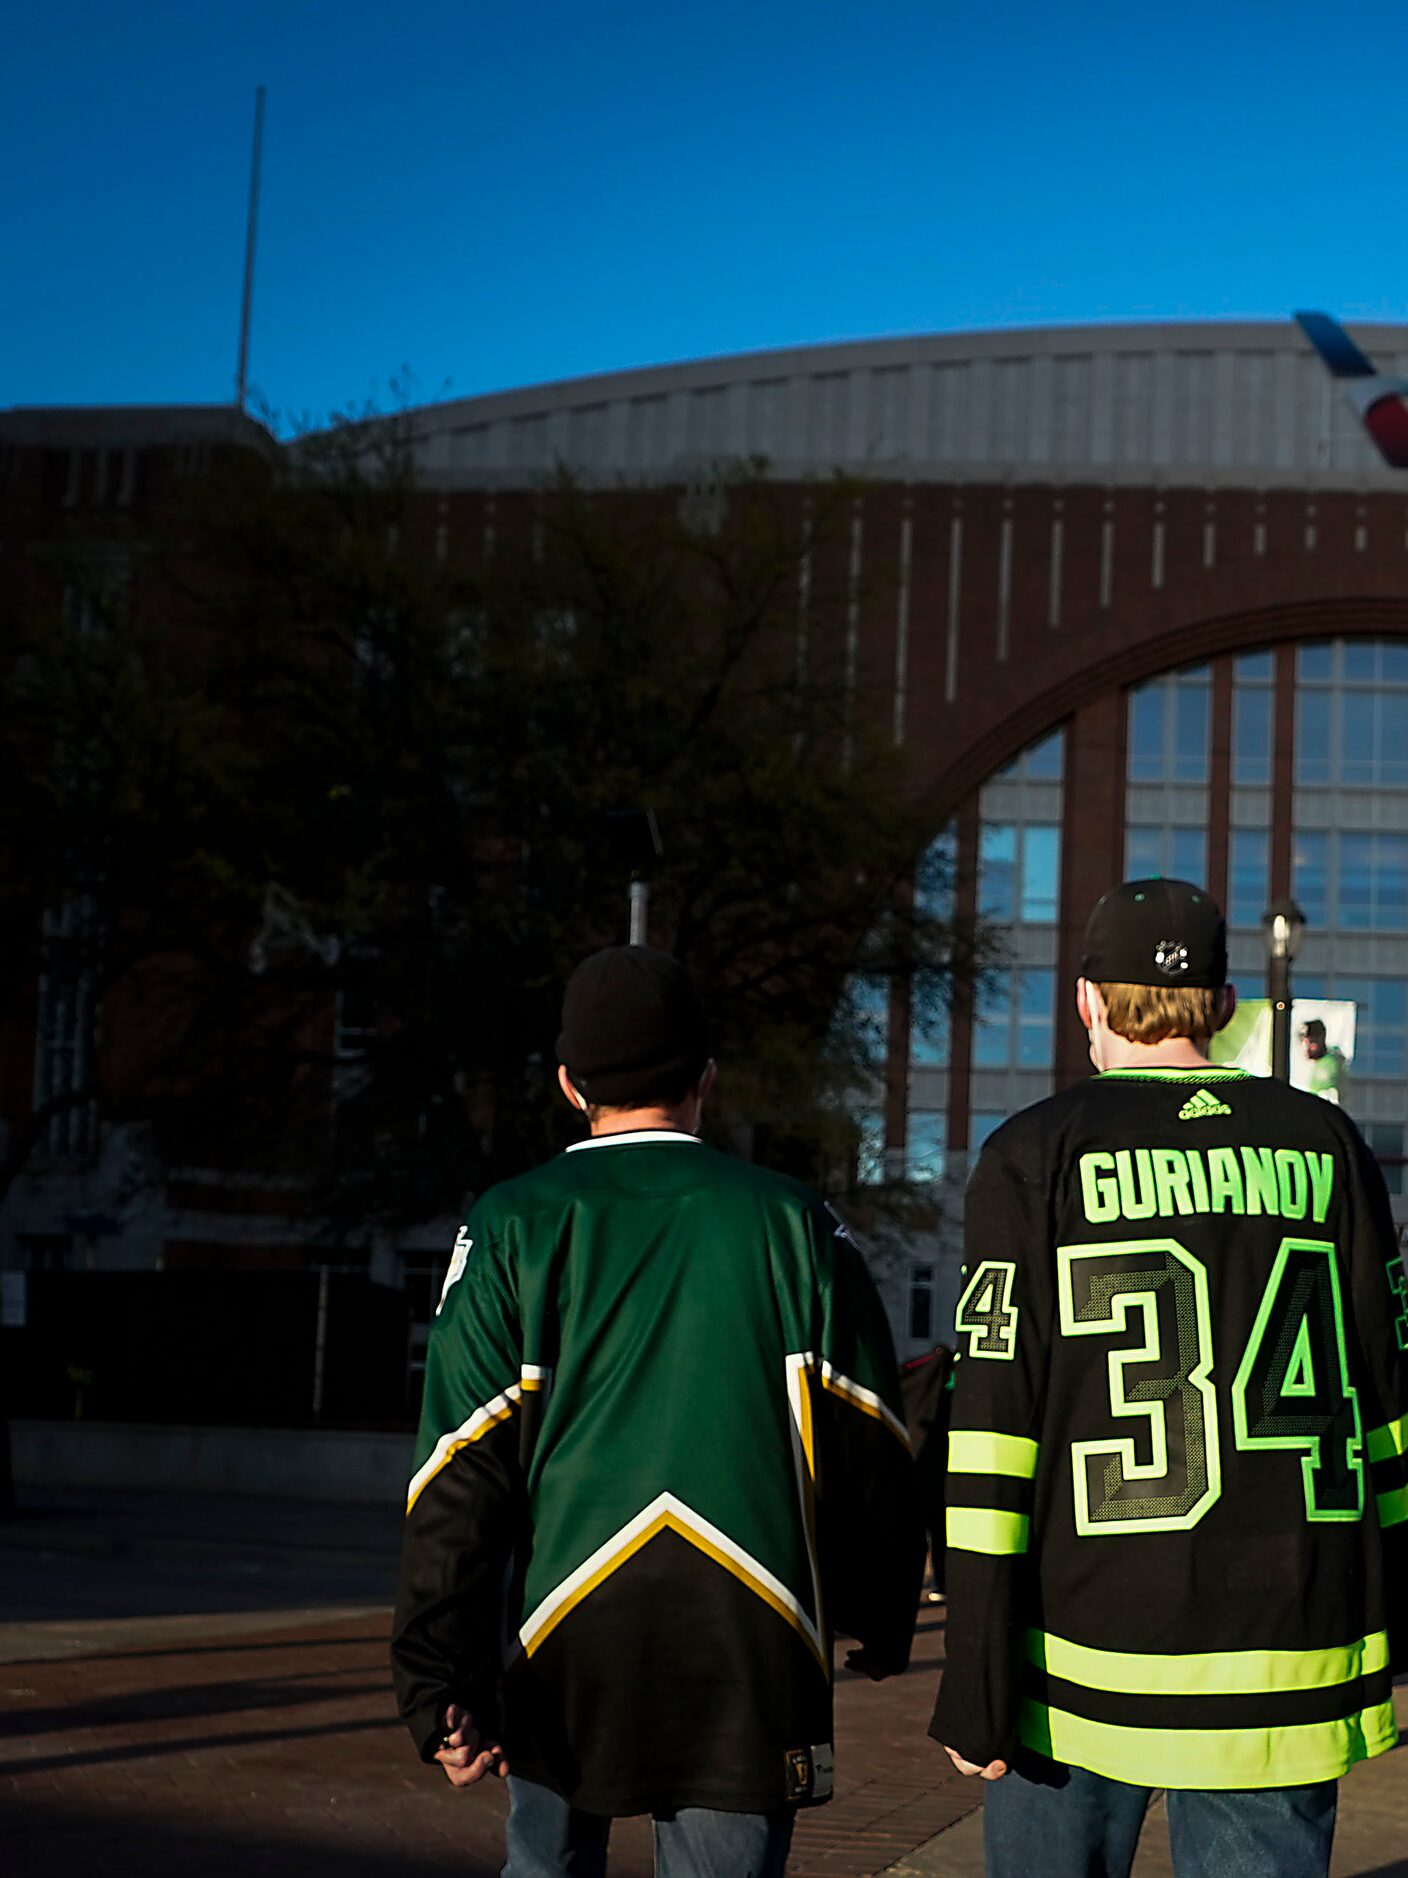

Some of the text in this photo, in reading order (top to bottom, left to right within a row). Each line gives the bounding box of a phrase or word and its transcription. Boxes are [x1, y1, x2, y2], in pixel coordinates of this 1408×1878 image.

[1178, 1103, 1232, 1120] adidas
[1079, 1147, 1334, 1223] GURIANOV
[1057, 1238, 1365, 1536] 34
